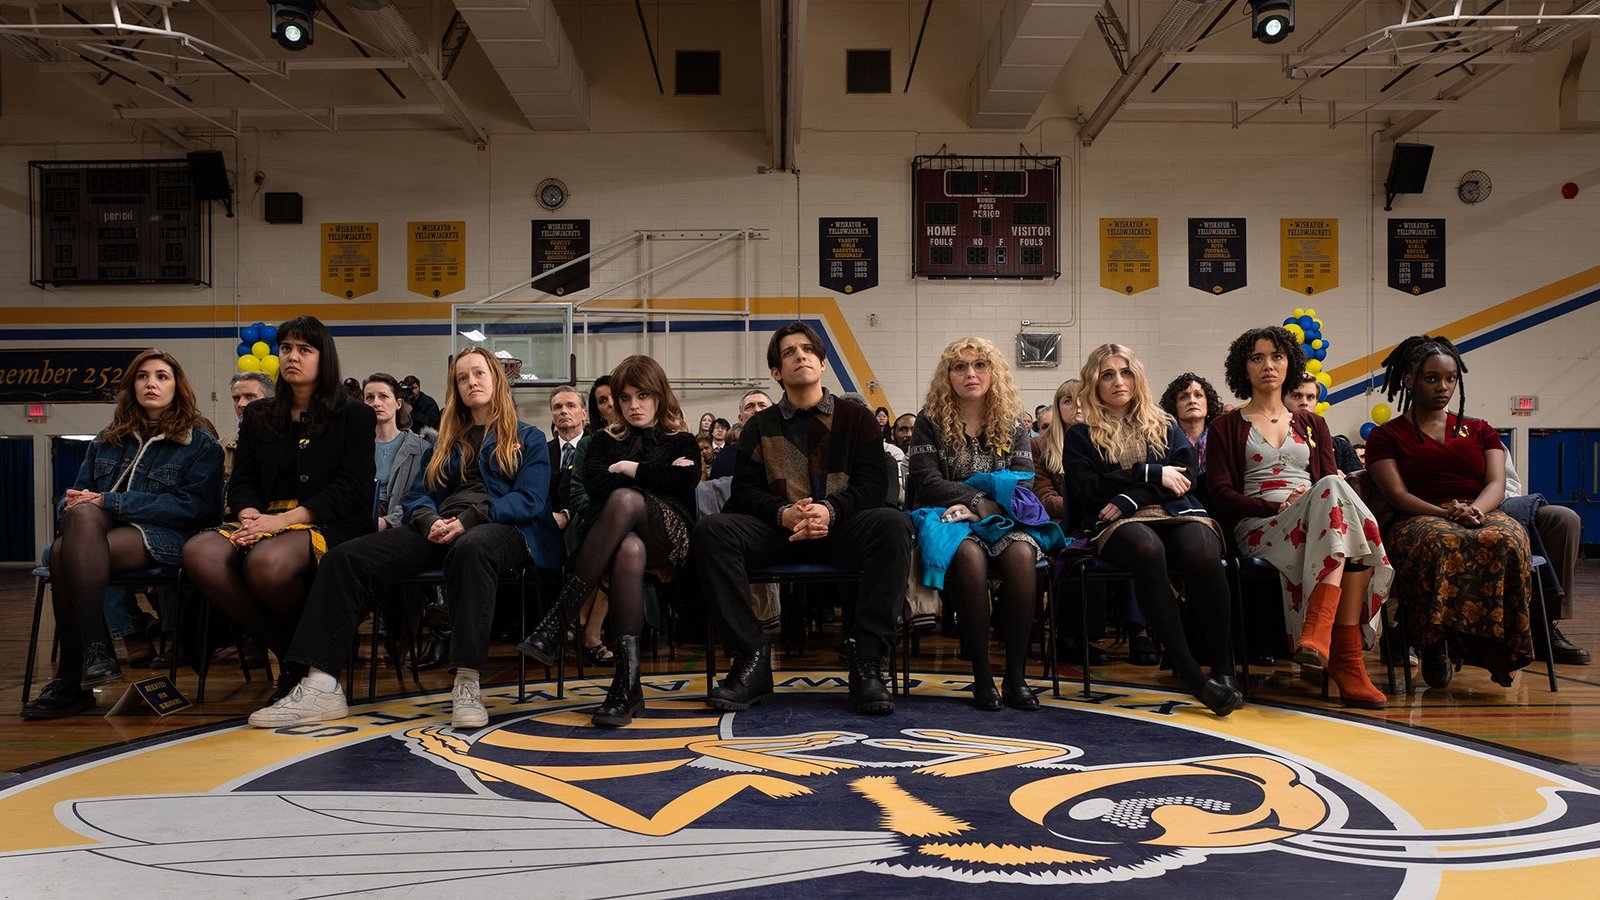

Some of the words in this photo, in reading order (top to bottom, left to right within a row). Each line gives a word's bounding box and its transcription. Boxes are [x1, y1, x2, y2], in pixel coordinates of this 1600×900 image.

[104, 210, 133, 222] period
[973, 210, 1001, 218] PERIOD
[927, 226, 957, 236] HOME
[1011, 226, 1052, 236] VISITOR
[328, 233, 372, 241] YELLOWJACKETS
[930, 238, 954, 246] FOULS
[972, 238, 984, 246] NO
[999, 238, 1005, 246] F
[1020, 238, 1044, 246] FOULS
